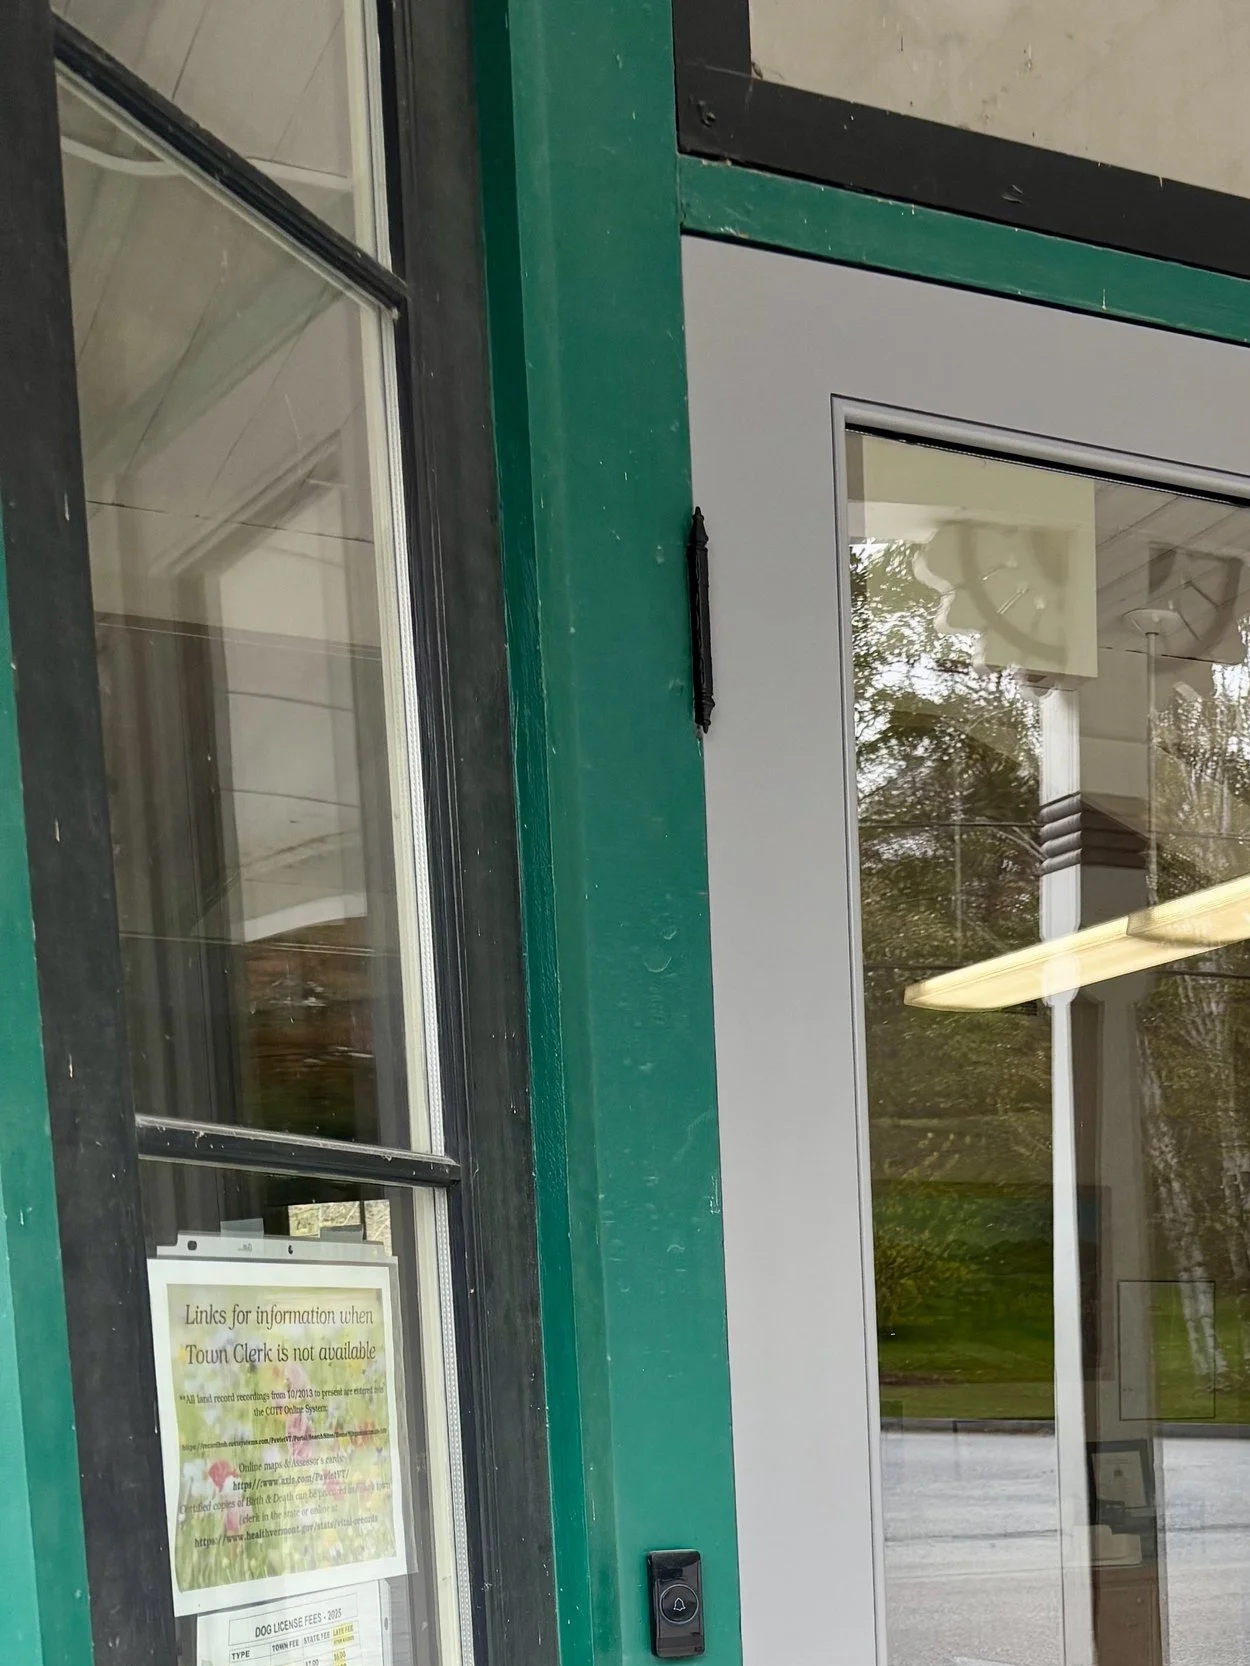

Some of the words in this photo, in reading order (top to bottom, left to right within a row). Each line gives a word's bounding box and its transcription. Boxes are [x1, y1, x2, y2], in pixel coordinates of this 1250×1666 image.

[185, 1305, 226, 1324] Links
[229, 1304, 251, 1330] for
[256, 1304, 337, 1330] information
[340, 1306, 373, 1324] when
[186, 1344, 228, 1364] Town
[234, 1343, 272, 1363] Clerk
[277, 1344, 288, 1361] is
[293, 1344, 314, 1361] not
[319, 1341, 375, 1360] available
[237, 1392, 269, 1403] recordings
[271, 1390, 286, 1400] from
[288, 1389, 313, 1399] 10/2013
[322, 1388, 343, 1398] present
[284, 1405, 303, 1415] Online
[239, 1462, 262, 1472] Online
[264, 1461, 282, 1472] maps
[213, 1500, 236, 1512] copies
[236, 1496, 245, 1508] of
[246, 1495, 264, 1507] Birth
[266, 1494, 272, 1504] &
[273, 1492, 294, 1503] Death
[255, 1625, 272, 1637] DOG
[274, 1617, 302, 1633] LICENSE
[305, 1613, 321, 1626] FEES
[328, 1608, 341, 1621] 2025
[232, 1650, 250, 1660] TYPE
[272, 1642, 288, 1652] TOWN
[304, 1634, 320, 1644] STATE
